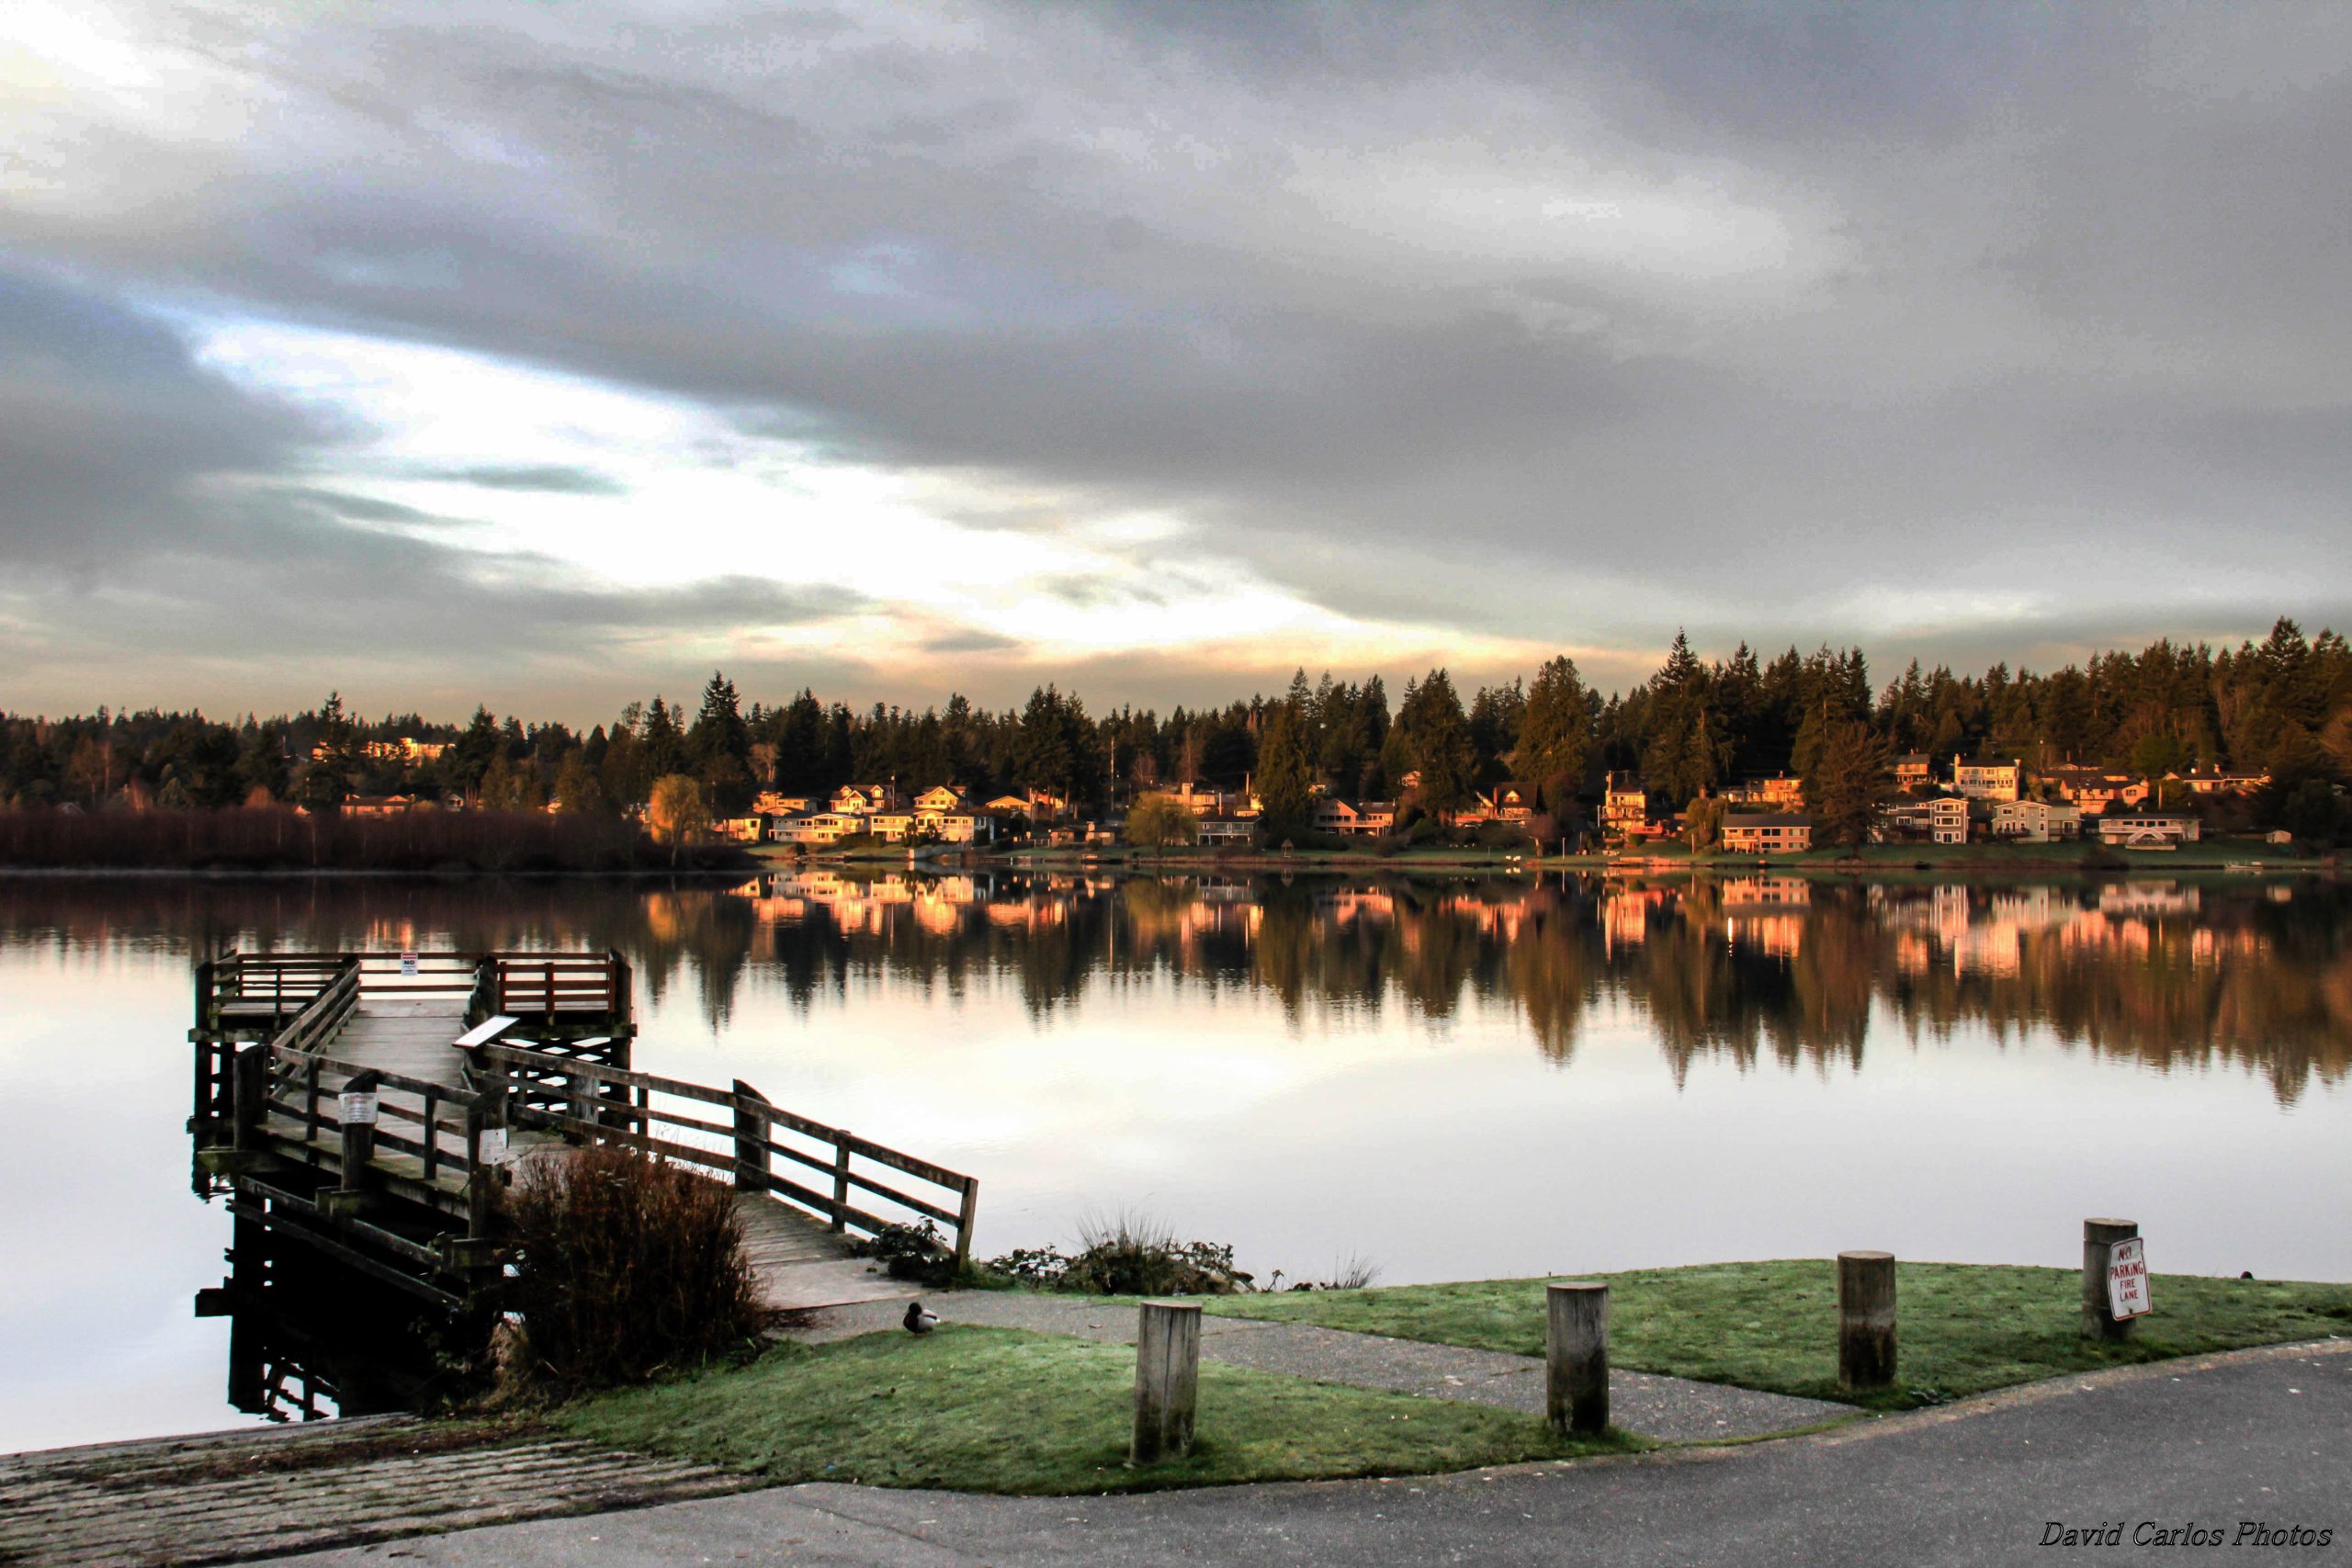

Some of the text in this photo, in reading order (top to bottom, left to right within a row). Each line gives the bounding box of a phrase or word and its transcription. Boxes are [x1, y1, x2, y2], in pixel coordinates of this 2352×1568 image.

[2119, 1247, 2132, 1260] NO
[2110, 1261, 2143, 1280] PARKING
[2120, 1279, 2135, 1289] FIRE
[2120, 1290, 2138, 1302] LANE
